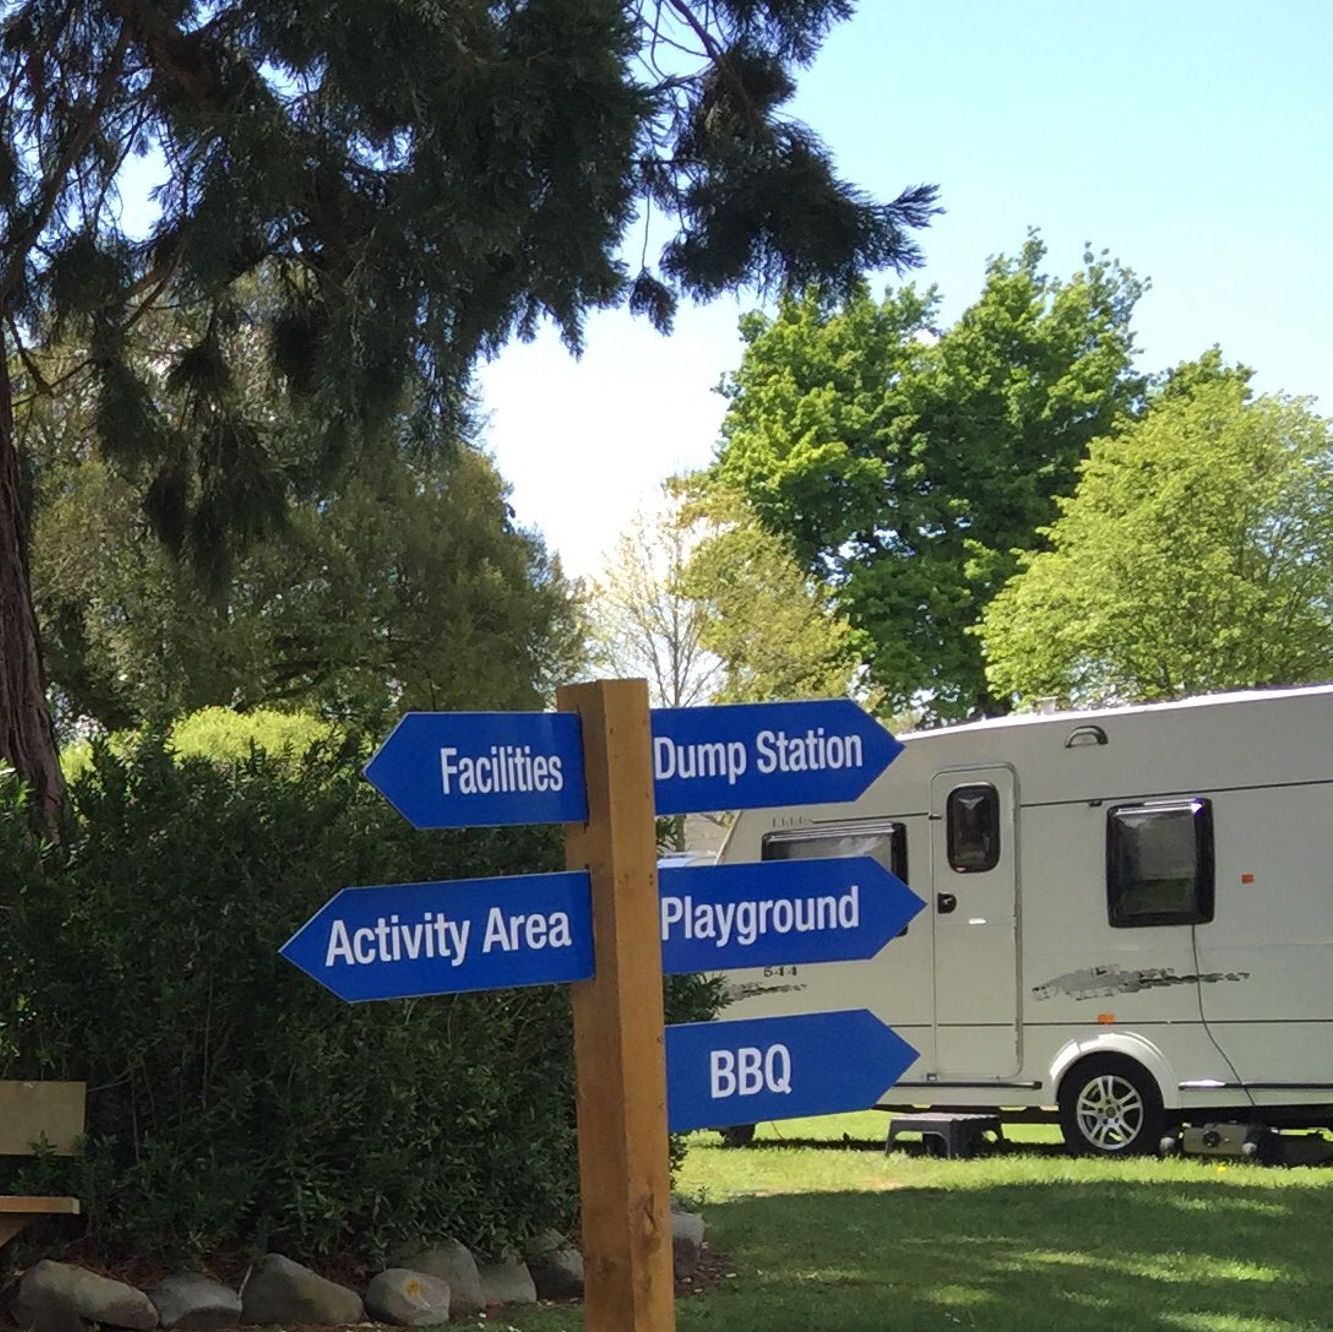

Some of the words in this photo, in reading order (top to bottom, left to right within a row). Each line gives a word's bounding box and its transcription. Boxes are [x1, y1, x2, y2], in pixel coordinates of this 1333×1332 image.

[440, 744, 563, 795] Facilities
[654, 736, 746, 784] Dump
[756, 727, 863, 773] Station
[325, 912, 471, 967] Activity
[482, 906, 573, 954] Area
[660, 885, 860, 949] Playground
[710, 1043, 793, 1099] BBQ
